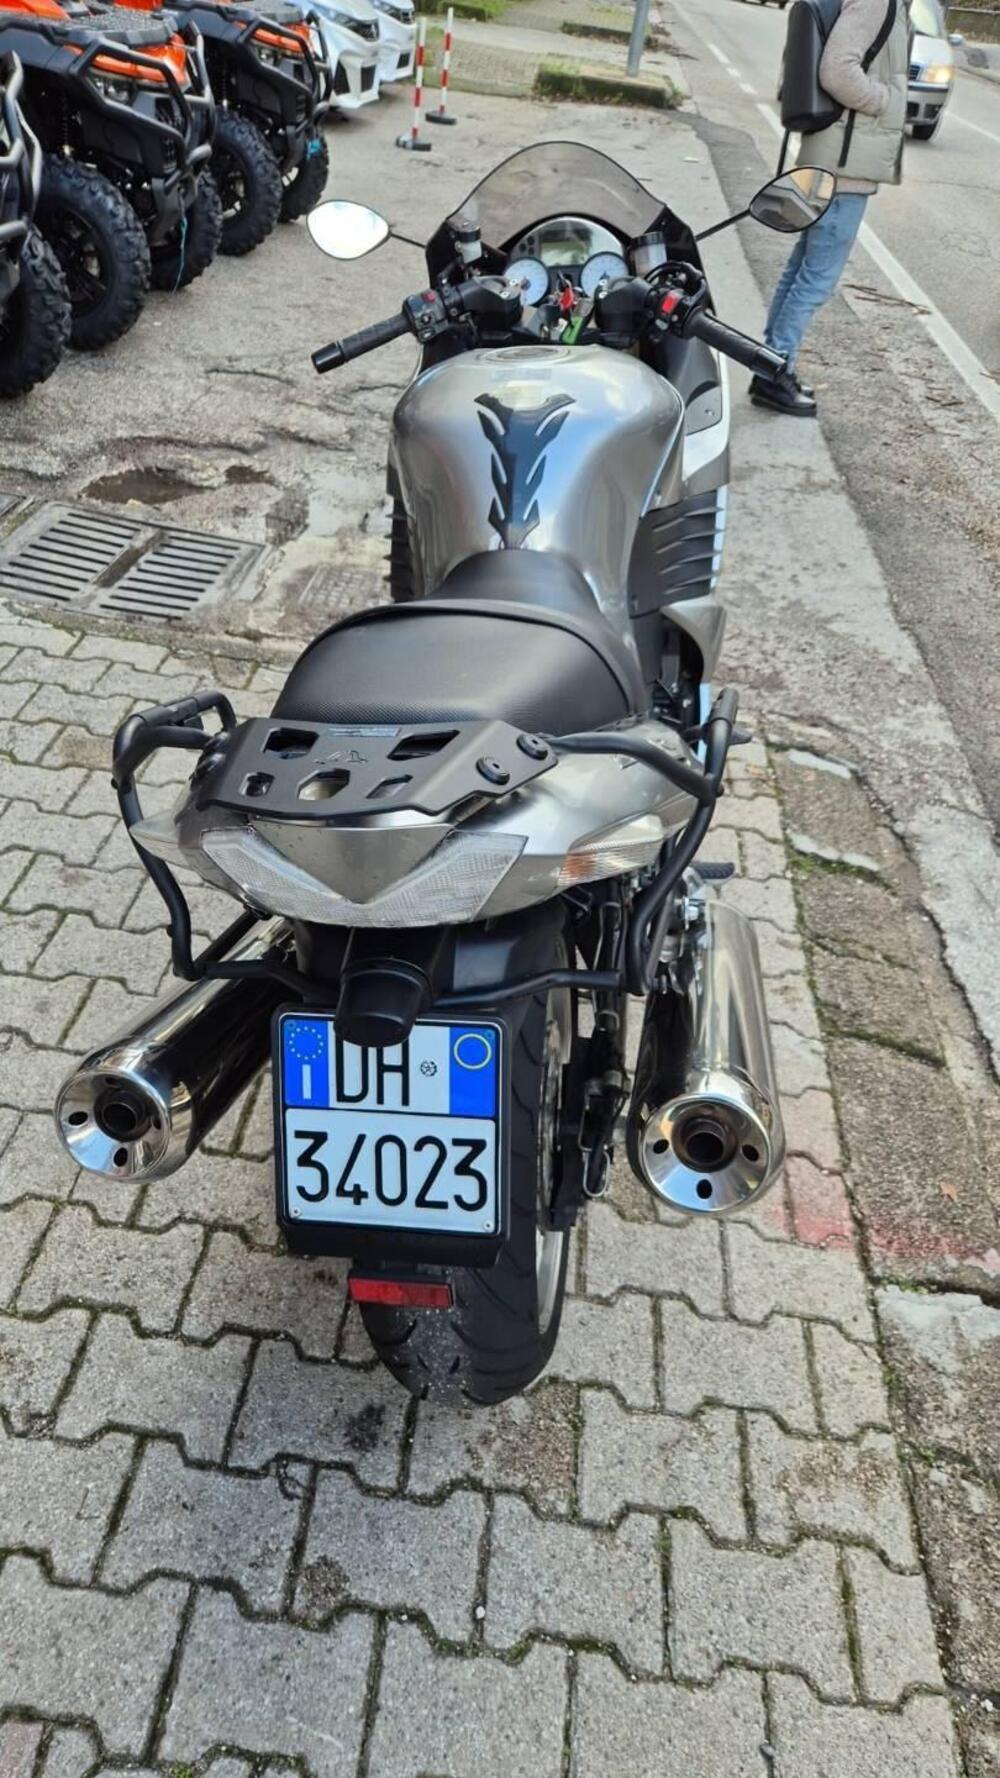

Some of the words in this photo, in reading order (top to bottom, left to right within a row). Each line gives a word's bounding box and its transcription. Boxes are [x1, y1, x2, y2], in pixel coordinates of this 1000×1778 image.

[302, 1064, 312, 1100] I
[335, 1038, 410, 1106] DH
[294, 1130, 488, 1212] 34023
